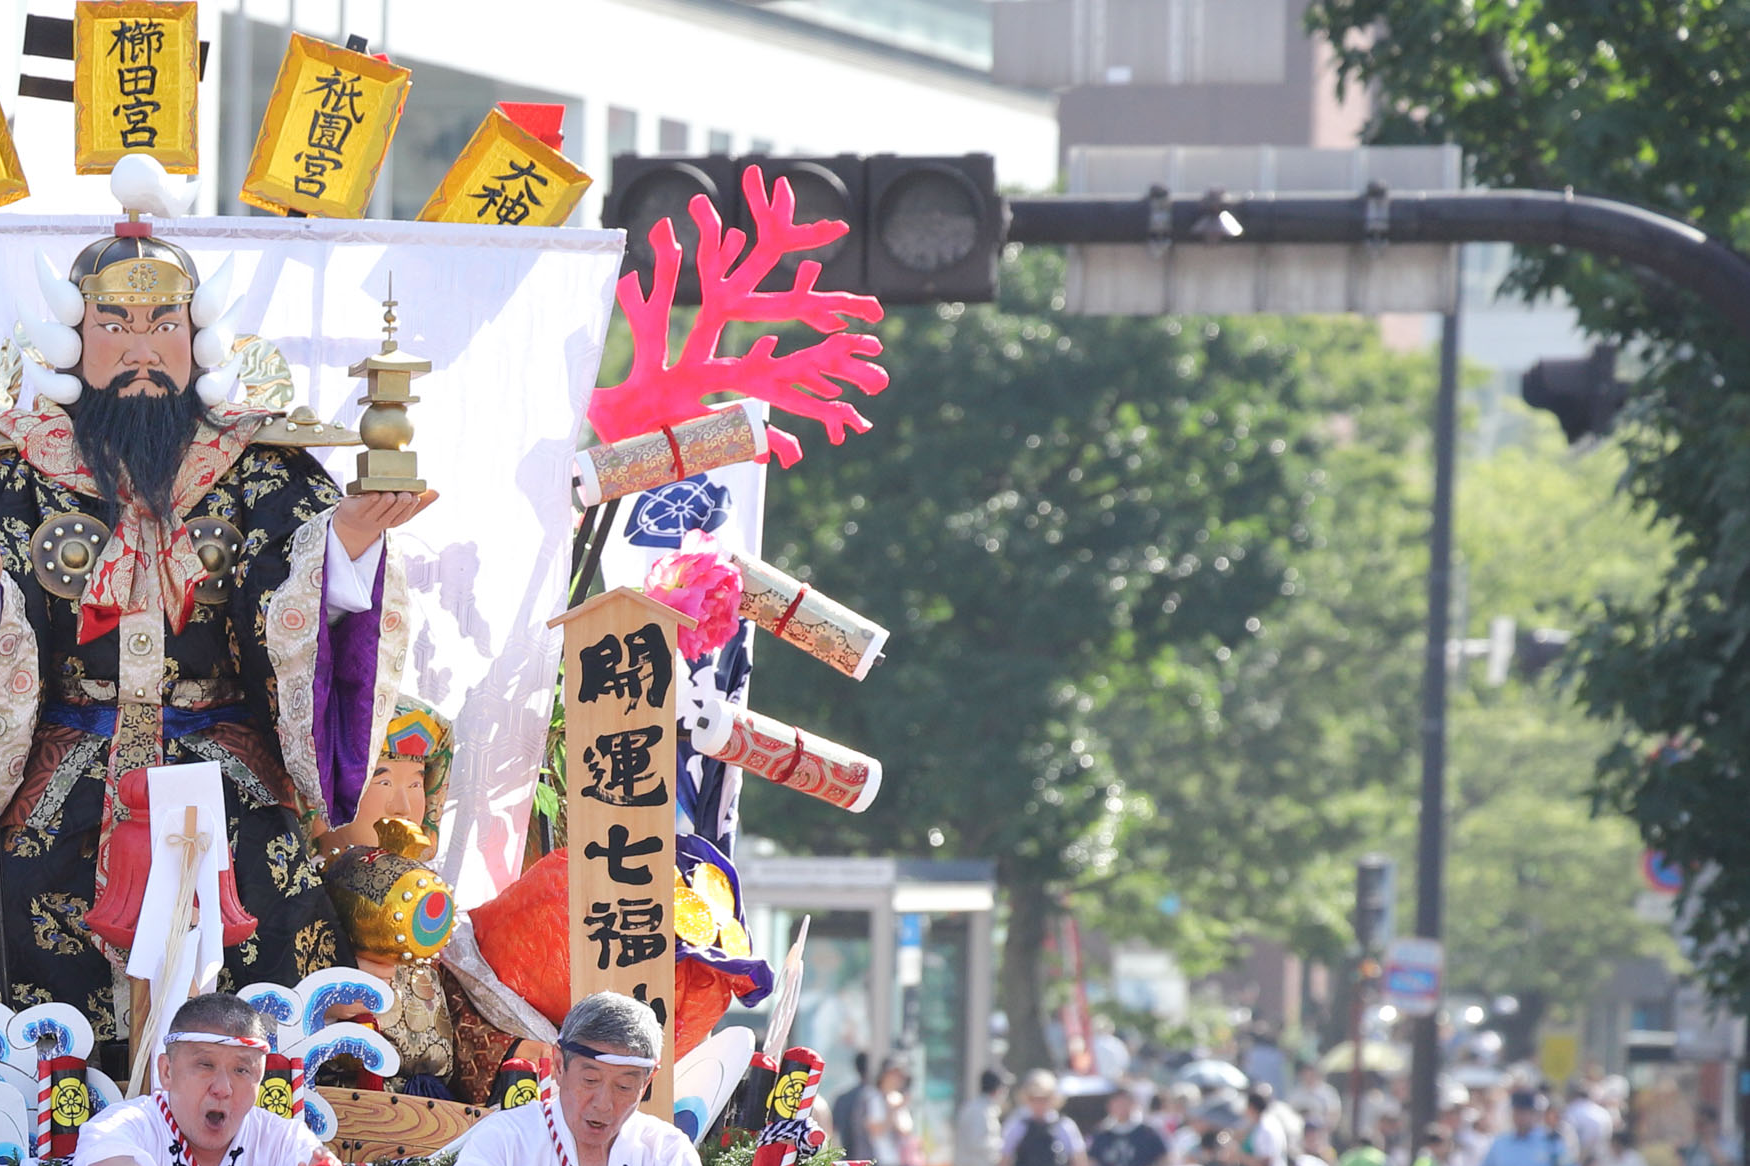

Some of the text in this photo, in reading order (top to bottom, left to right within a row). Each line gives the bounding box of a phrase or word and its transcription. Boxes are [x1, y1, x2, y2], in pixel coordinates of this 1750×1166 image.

[107, 19, 164, 149] 櫛田宮
[577, 623, 672, 1032] 開運七福
